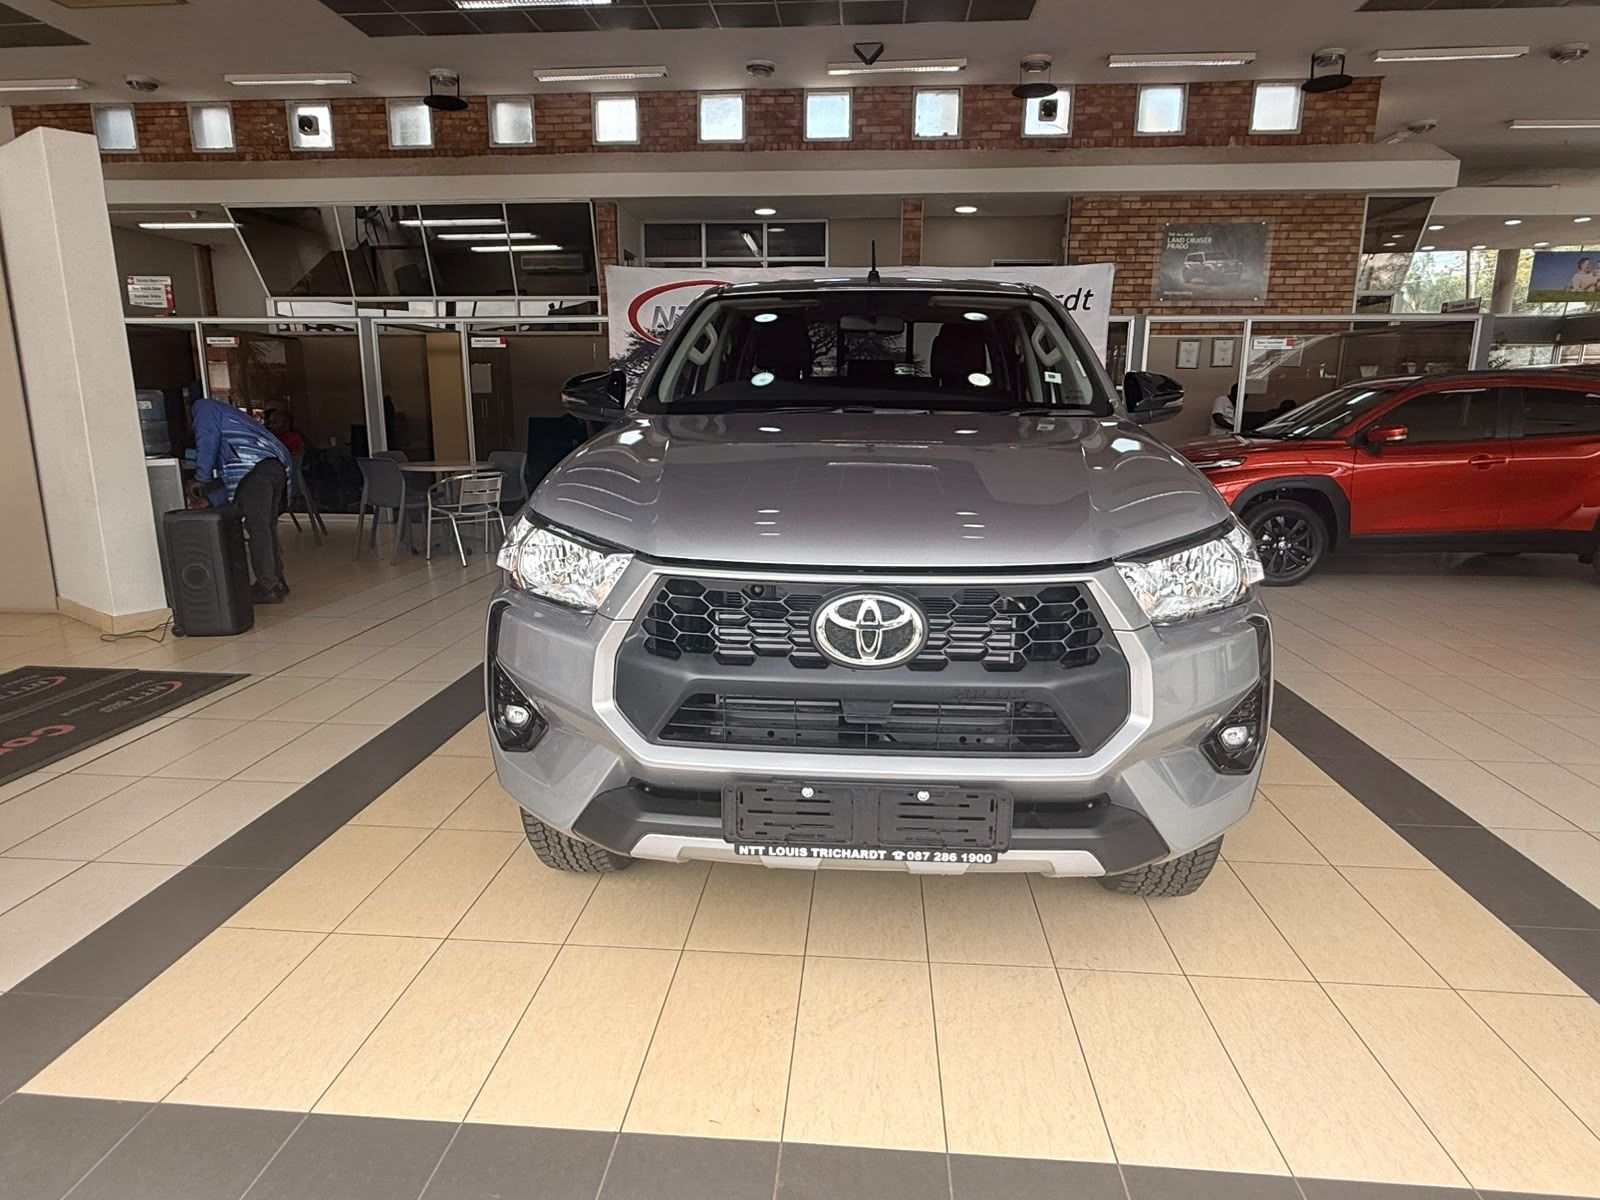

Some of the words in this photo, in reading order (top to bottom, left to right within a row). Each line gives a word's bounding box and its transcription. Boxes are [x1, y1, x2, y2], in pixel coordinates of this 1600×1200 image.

[739, 845, 765, 855] NTT
[768, 847, 808, 857] LOUIS
[811, 848, 887, 859] TRICHARDT
[906, 851, 931, 861] 087
[933, 852, 958, 862] 286
[960, 853, 993, 863] 1900
